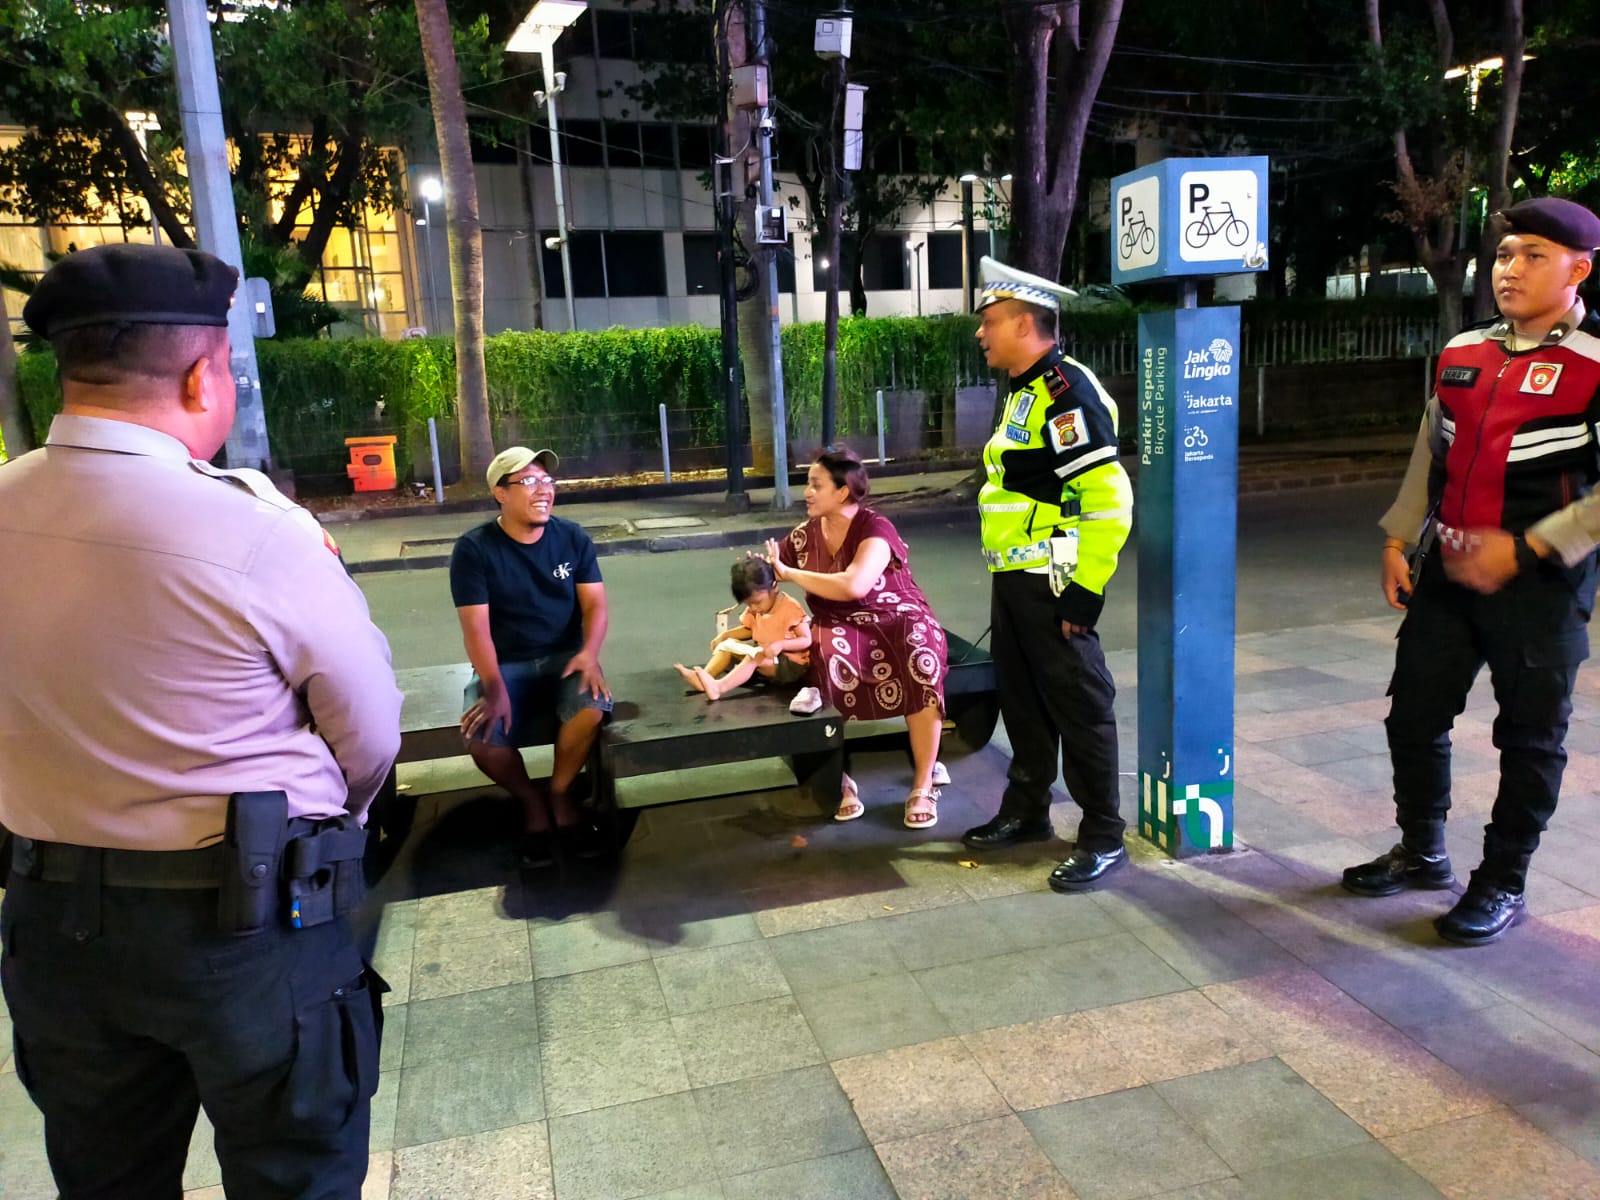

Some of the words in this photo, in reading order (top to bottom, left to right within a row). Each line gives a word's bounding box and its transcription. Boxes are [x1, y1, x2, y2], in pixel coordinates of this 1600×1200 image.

[1121, 196, 1133, 227] P
[1189, 183, 1210, 213] P
[1184, 349, 1210, 365] Jak
[1184, 364, 1231, 380] Lingko
[1142, 348, 1155, 411] Sepeda
[1155, 347, 1168, 400] Parking
[1187, 394, 1232, 409] Jakarta
[1141, 416, 1152, 465] Parkir
[1155, 405, 1167, 455] Bicycle
